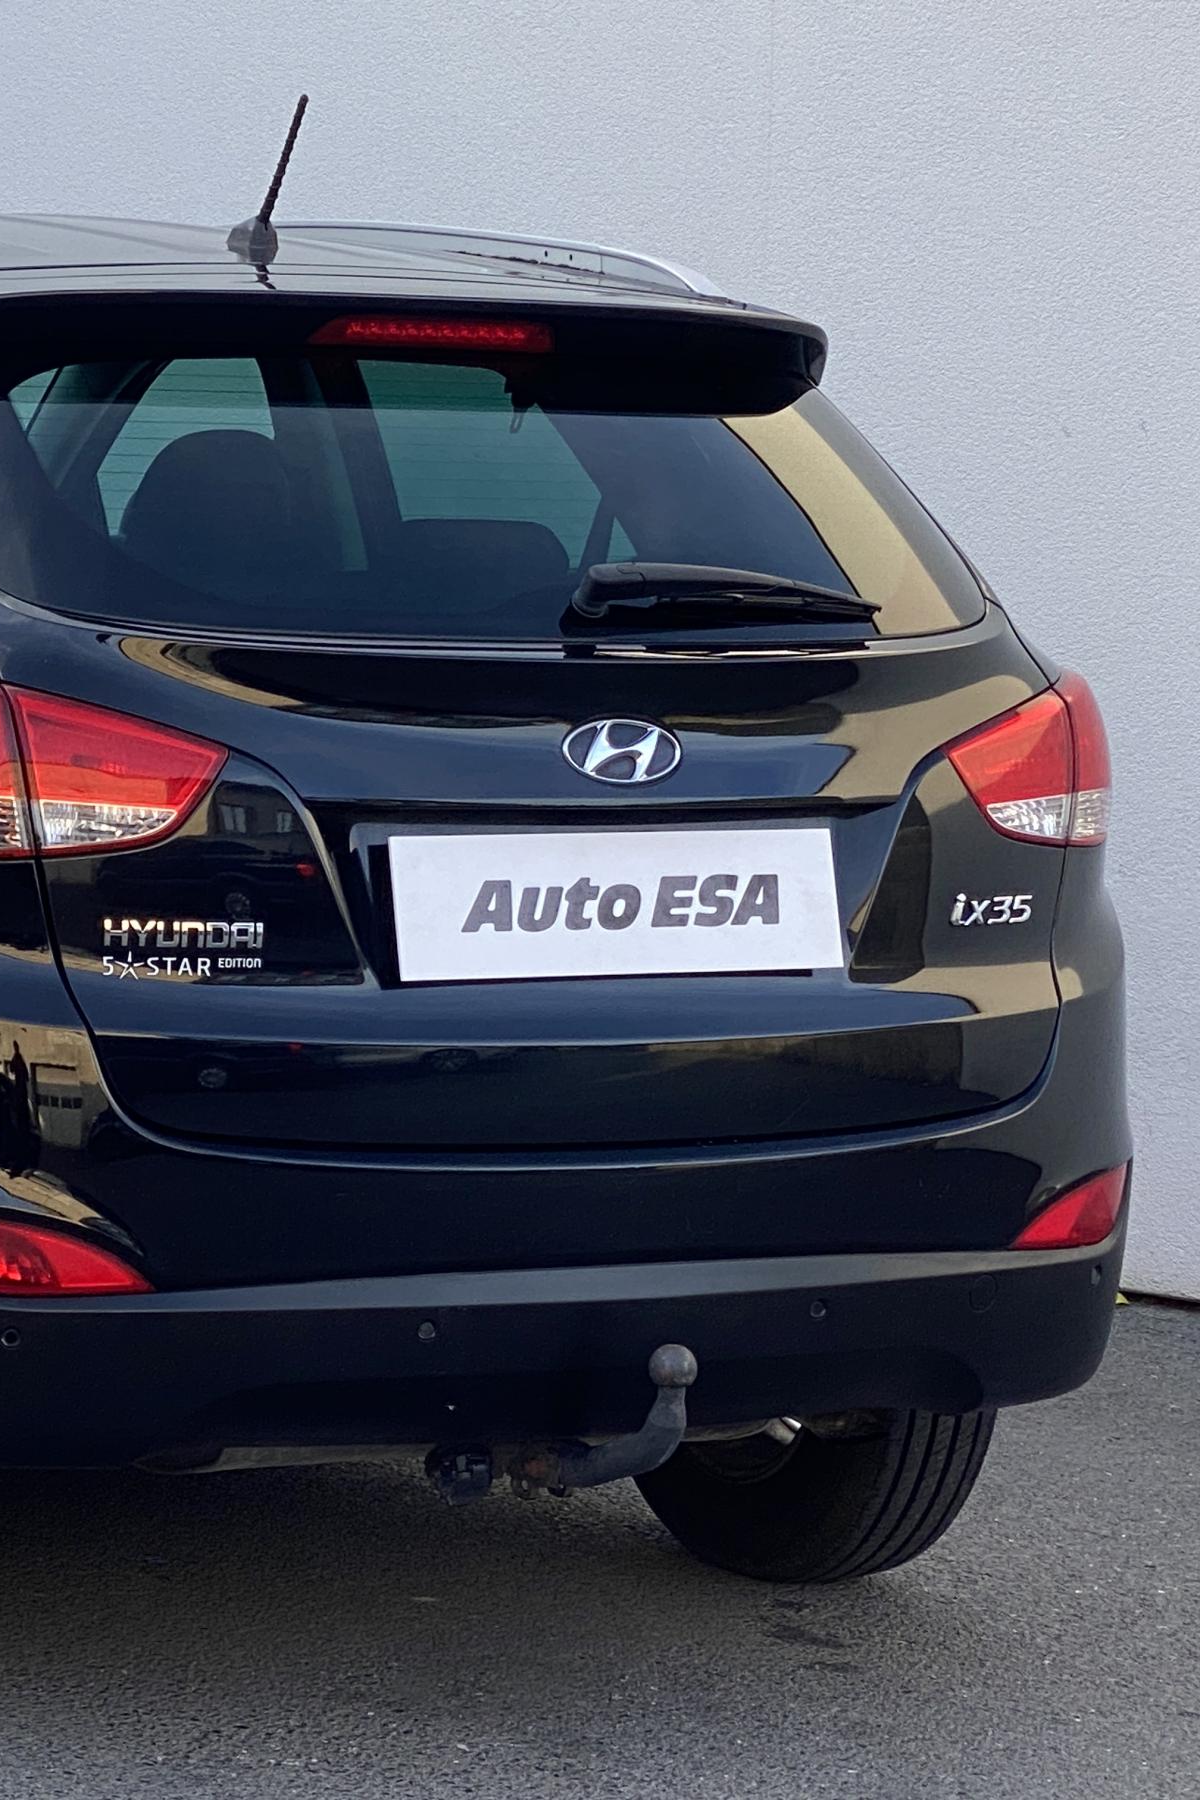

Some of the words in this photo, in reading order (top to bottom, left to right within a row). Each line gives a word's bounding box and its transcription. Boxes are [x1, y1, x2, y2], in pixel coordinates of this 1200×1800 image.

[461, 877, 642, 933] Auto
[651, 874, 779, 927] ESA
[950, 893, 1032, 926] ix35
[103, 918, 264, 949] HYUNDAI
[146, 957, 211, 977] STAR
[218, 957, 262, 968] EDITION
